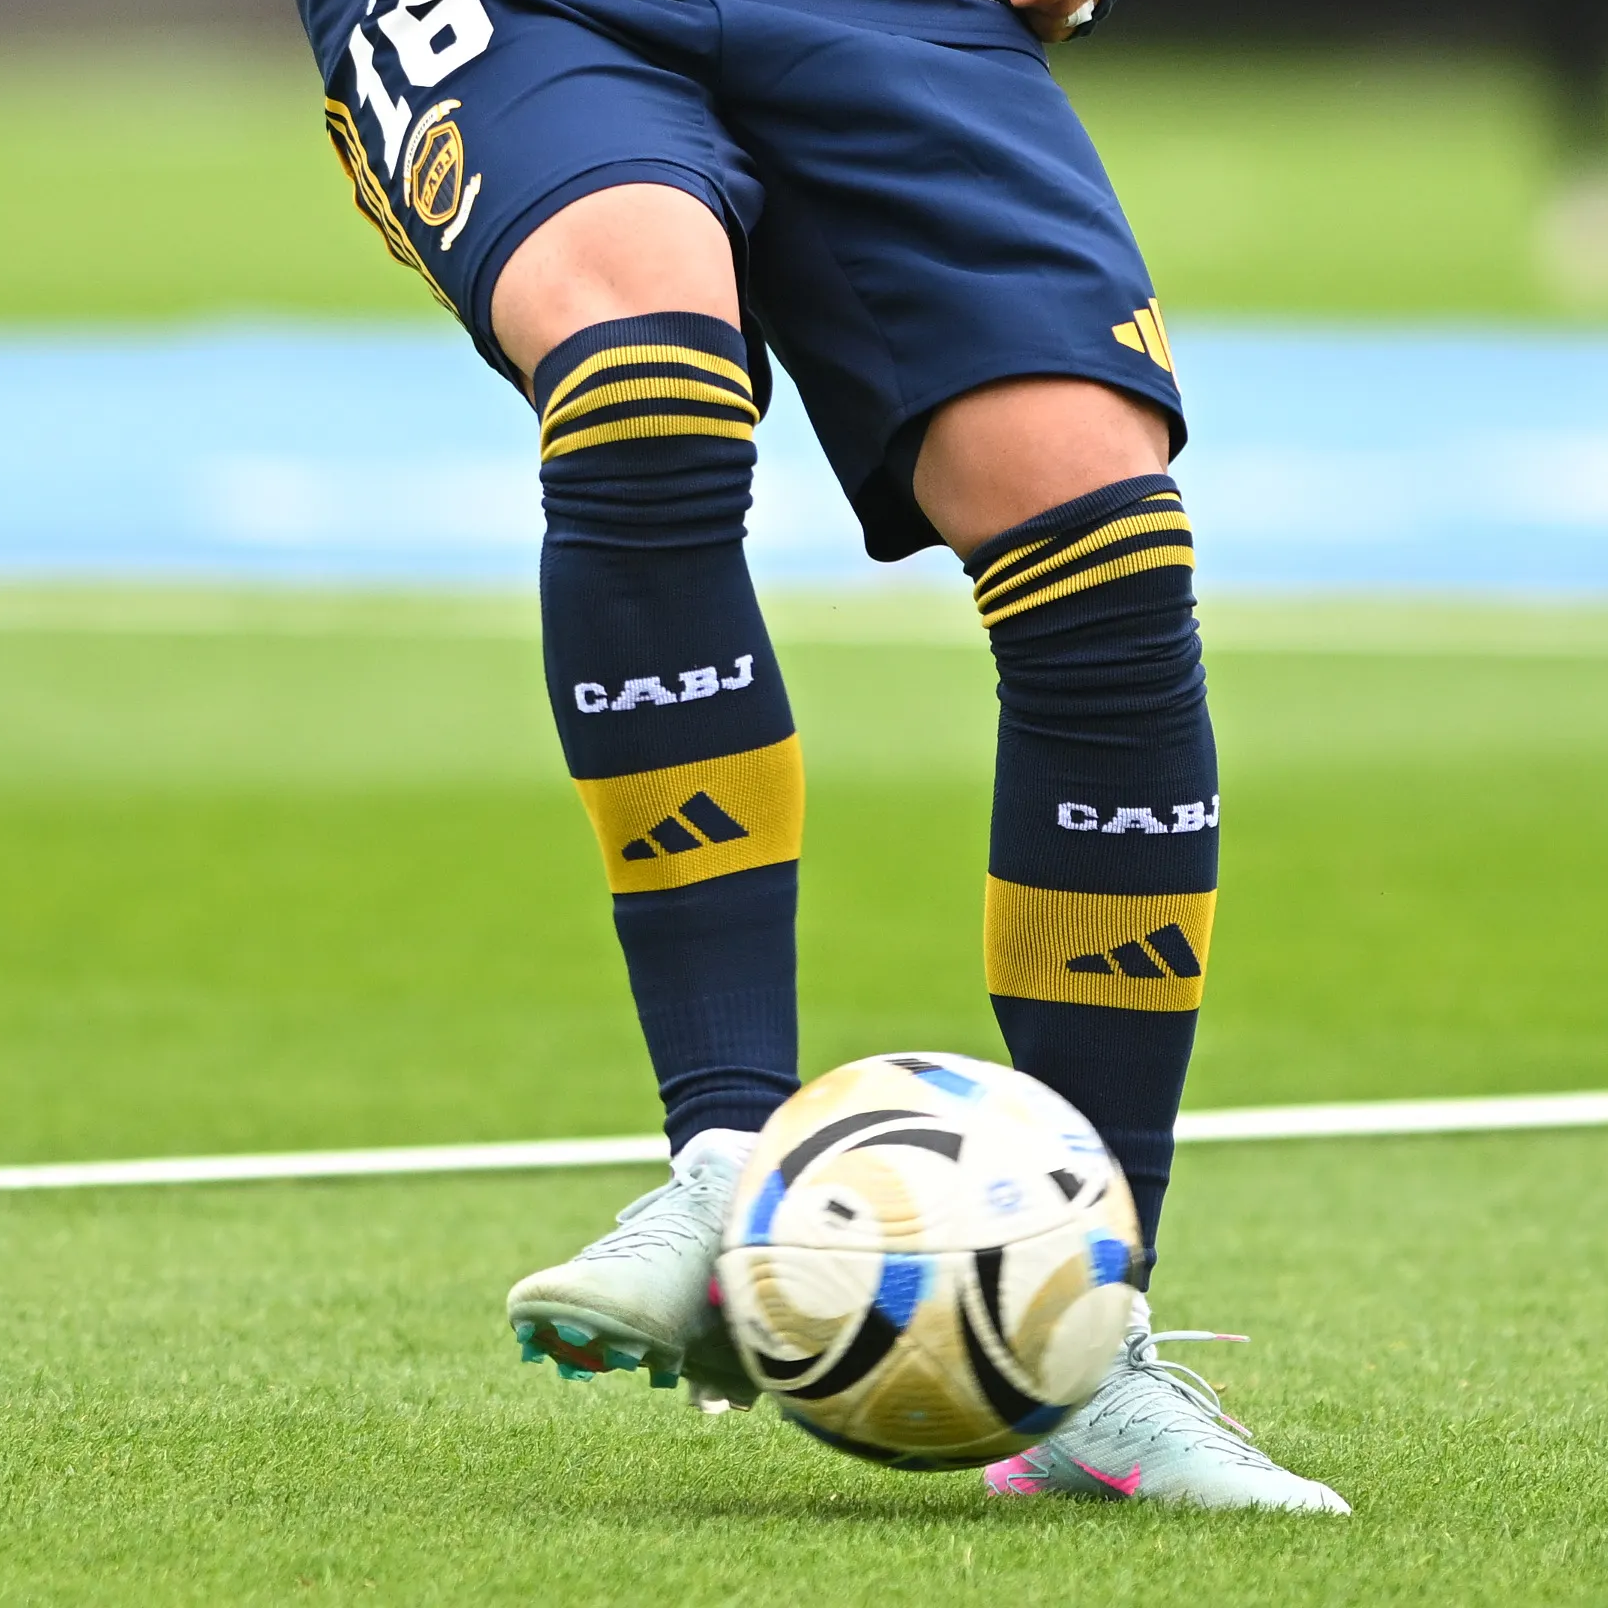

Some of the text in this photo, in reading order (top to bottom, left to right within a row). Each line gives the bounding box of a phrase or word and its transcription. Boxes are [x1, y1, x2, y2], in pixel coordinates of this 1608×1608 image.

[422, 147, 454, 208] CABJ
[574, 654, 754, 714] CABJ
[1057, 794, 1220, 834] CABJ
